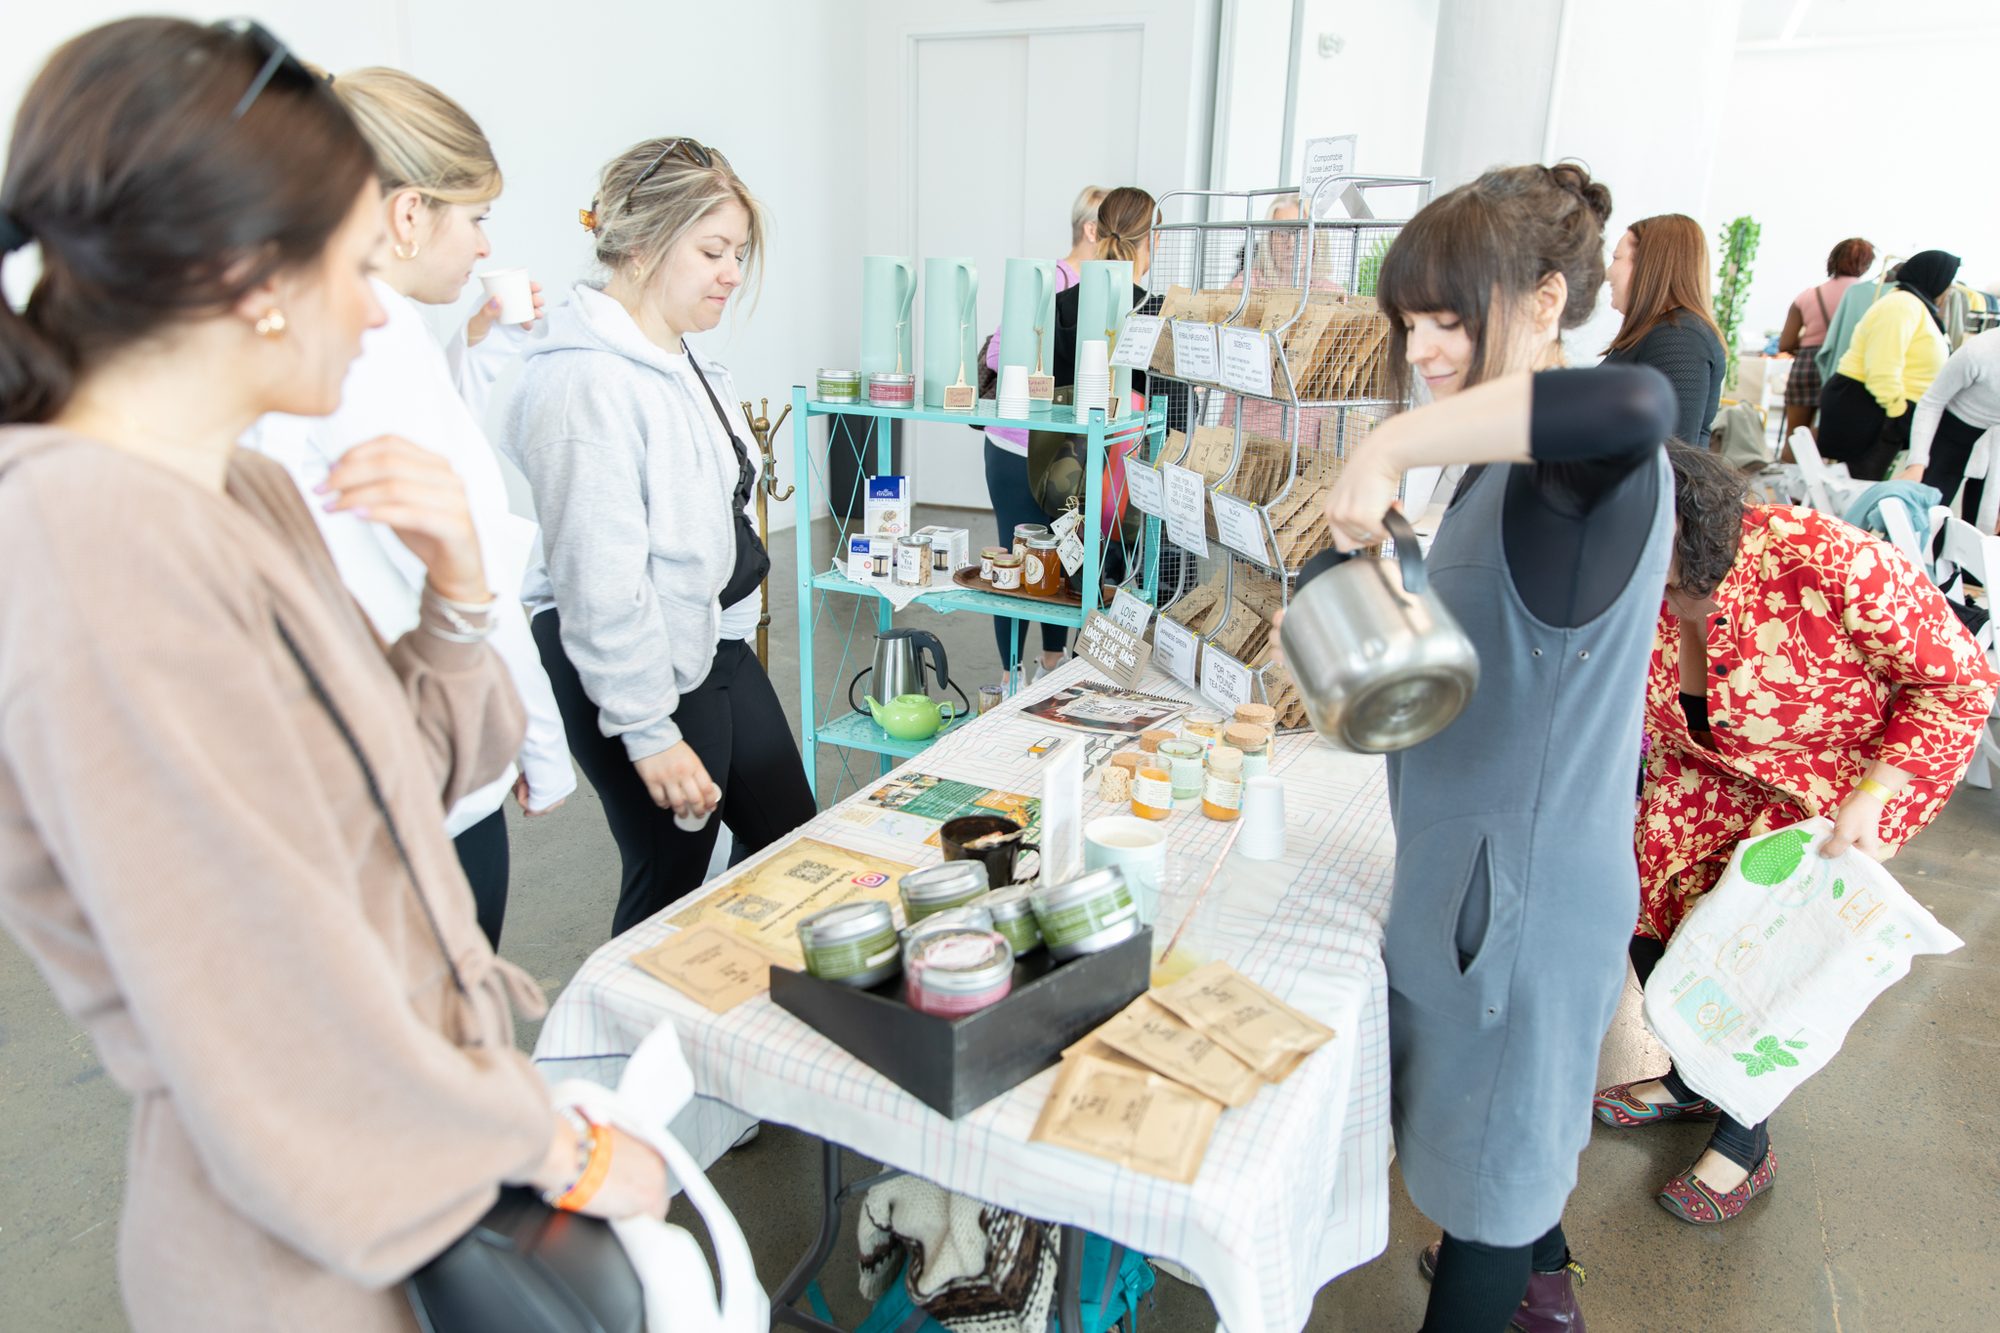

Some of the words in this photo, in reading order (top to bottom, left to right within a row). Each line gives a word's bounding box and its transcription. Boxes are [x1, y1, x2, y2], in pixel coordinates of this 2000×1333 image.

[1120, 604, 1137, 622] LOVE
[1094, 615, 1136, 650] COMPOSTABLE
[1084, 625, 1104, 644] LOOSE
[1102, 638, 1120, 654] LEAF
[1118, 648, 1136, 667] BAGS
[1098, 650, 1116, 670] EACH
[1214, 662, 1225, 675] FOR
[1226, 670, 1237, 682] THE
[1216, 673, 1234, 691] YOUNG
[1208, 678, 1220, 692] TEA
[1220, 684, 1241, 704] DRINKER
